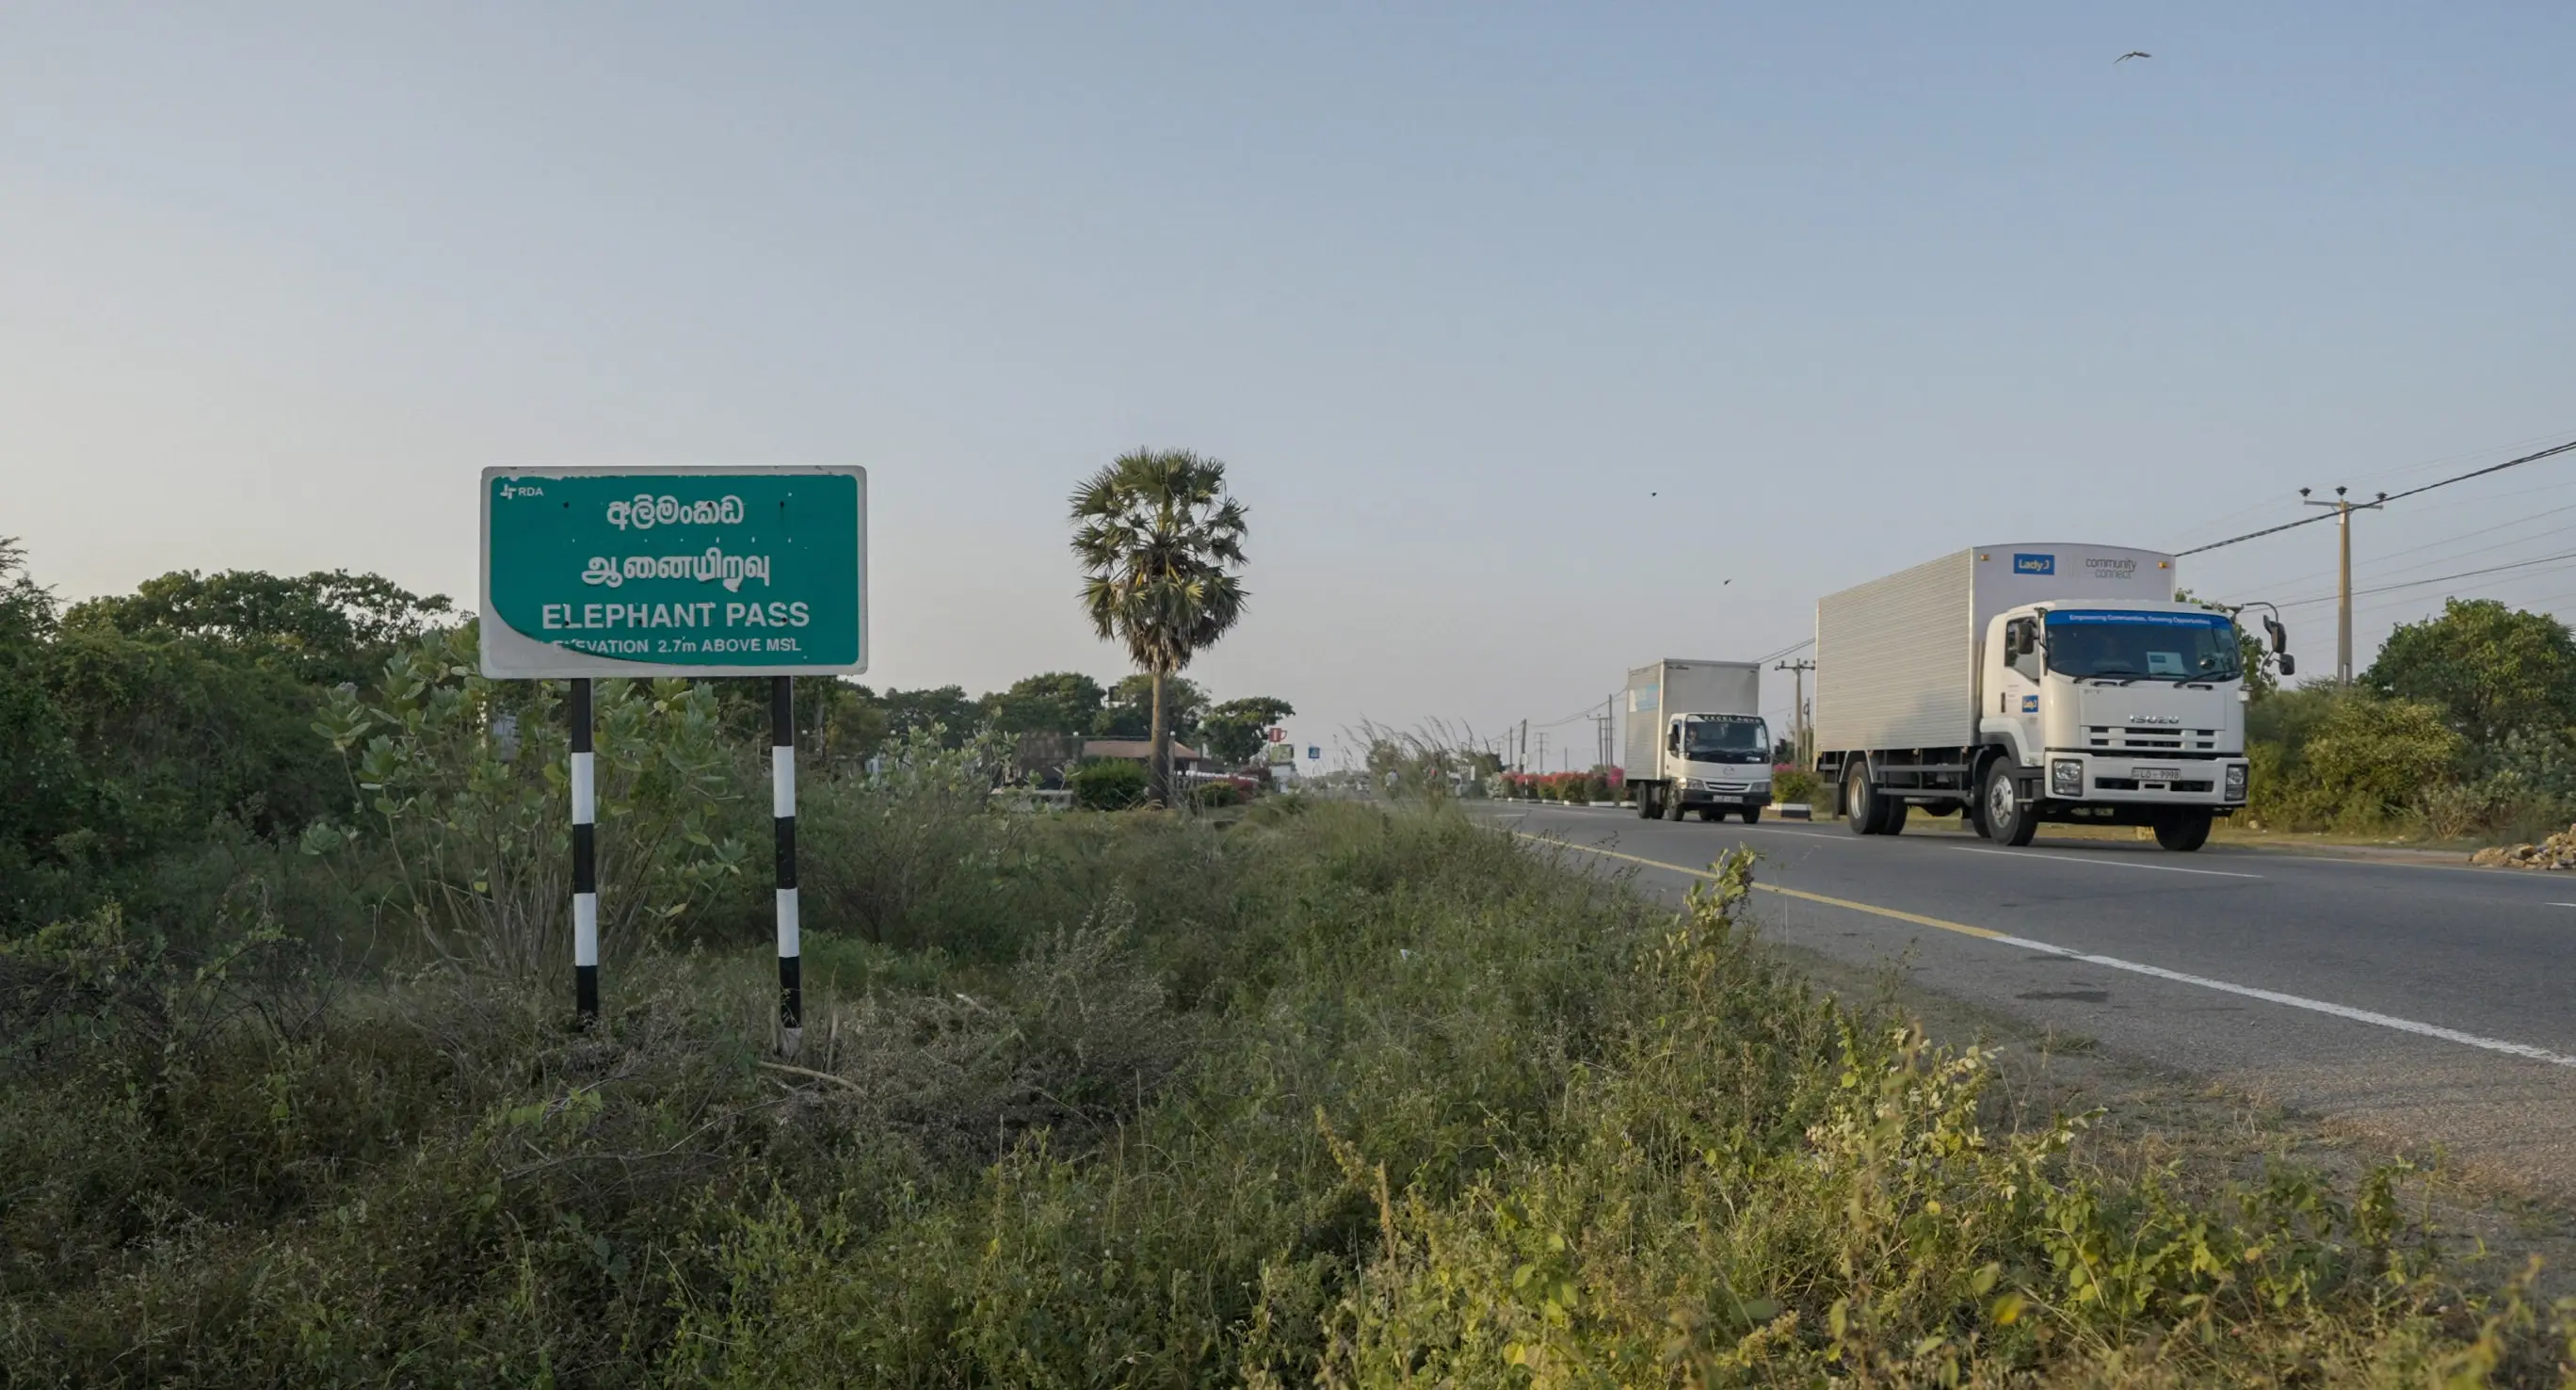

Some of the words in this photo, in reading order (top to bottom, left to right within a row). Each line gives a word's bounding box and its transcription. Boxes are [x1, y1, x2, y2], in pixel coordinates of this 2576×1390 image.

[519, 486, 544, 497] RDA
[606, 493, 745, 531] අලිමංකඩ
[582, 546, 770, 593] ஆனையிறவு
[2085, 558, 2137, 573] community
[541, 601, 716, 629] ELEPHANT
[726, 601, 811, 628] PASS
[657, 638, 697, 653] 2.7m
[701, 638, 762, 653] ABOVE
[766, 638, 802, 652] MSL
[2130, 714, 2180, 724] ISUZU
